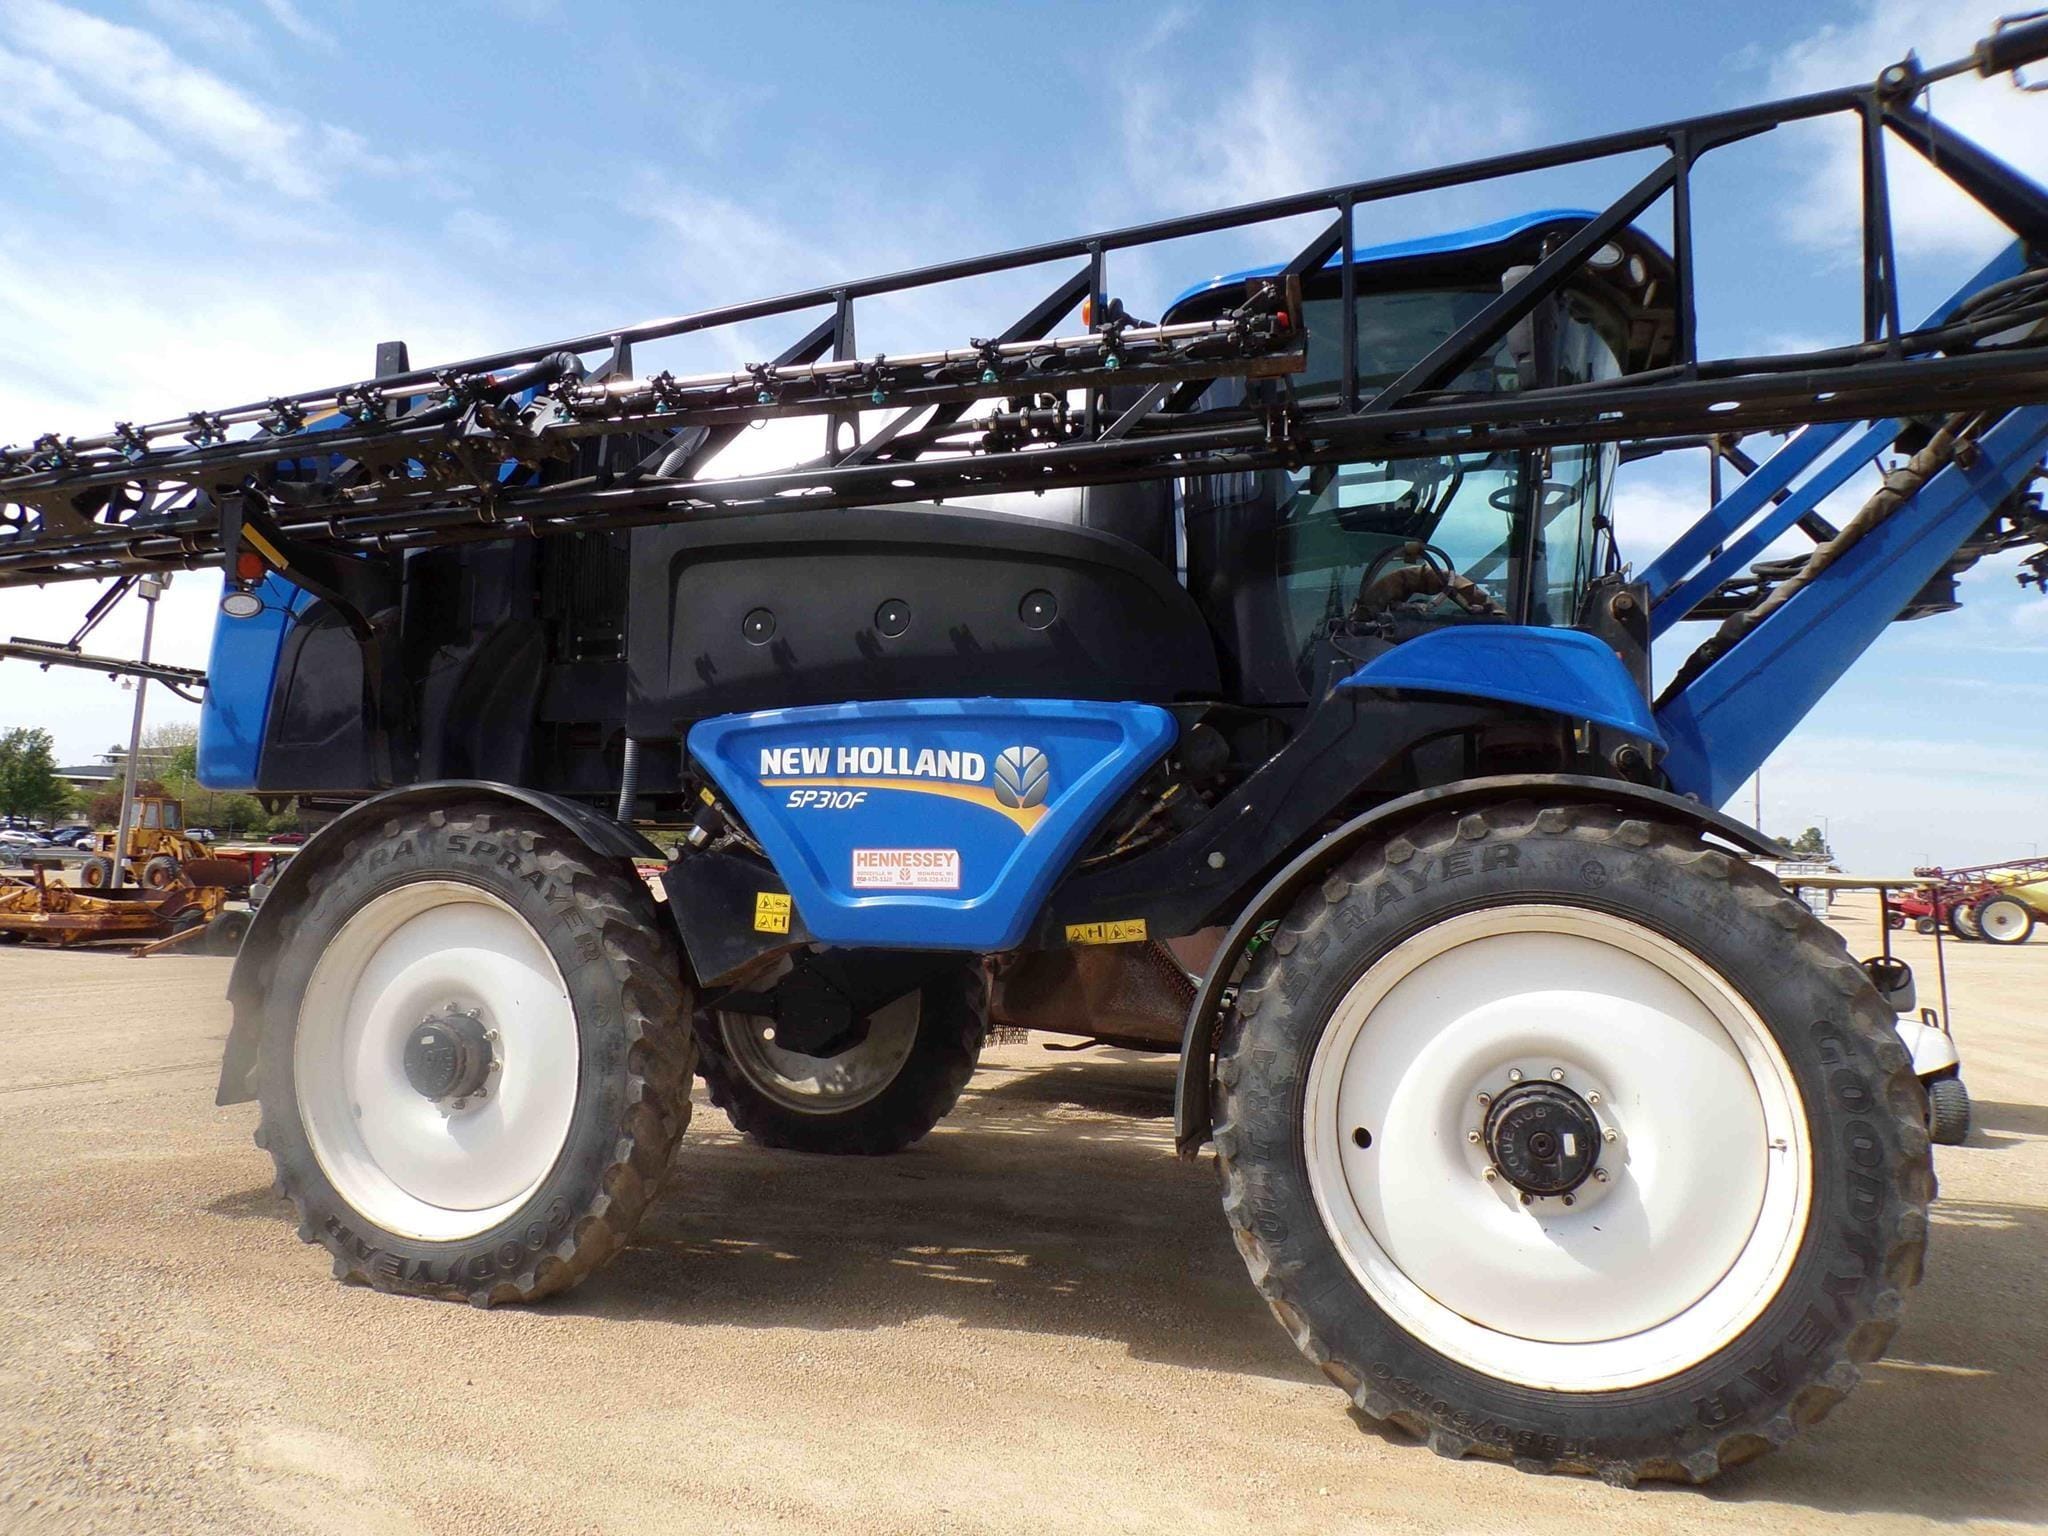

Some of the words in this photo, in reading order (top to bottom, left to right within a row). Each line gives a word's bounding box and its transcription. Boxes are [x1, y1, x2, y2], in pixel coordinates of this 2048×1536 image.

[760, 747, 830, 776] NEW
[837, 746, 985, 782] HOLLAND
[786, 790, 868, 809] SP310F
[446, 834, 600, 963] SPRAYER
[857, 852, 955, 867] HENNESSEY
[1282, 842, 1523, 1005] SPRAYER
[324, 1195, 574, 1283] GOODYEAR
[1695, 1018, 1885, 1431] GOODYEAR
